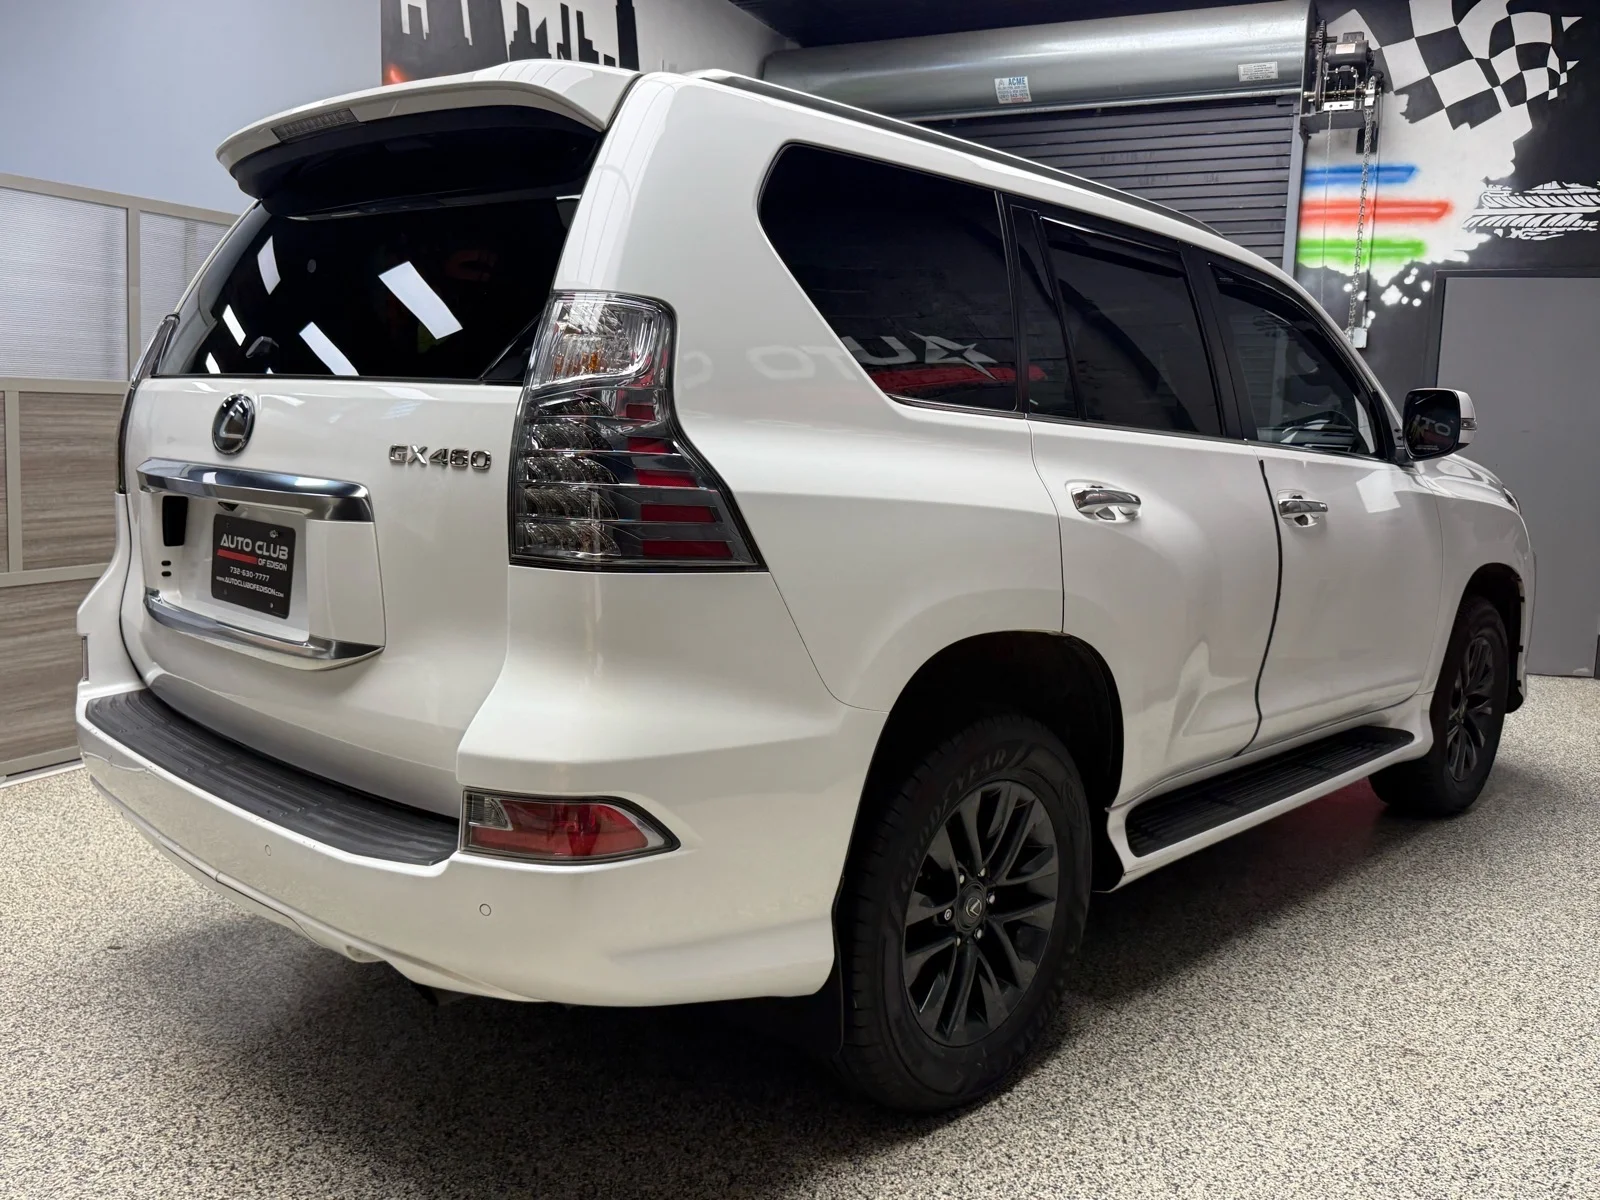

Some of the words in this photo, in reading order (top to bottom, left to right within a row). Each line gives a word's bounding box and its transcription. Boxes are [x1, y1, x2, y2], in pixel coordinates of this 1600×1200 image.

[1008, 77, 1026, 86] ACME
[388, 444, 493, 471] GX460
[221, 534, 252, 551] AUTO
[255, 541, 288, 559] CLUB
[258, 558, 266, 566] OF
[267, 560, 287, 571] EDISON
[230, 566, 270, 581] 732-630-7777
